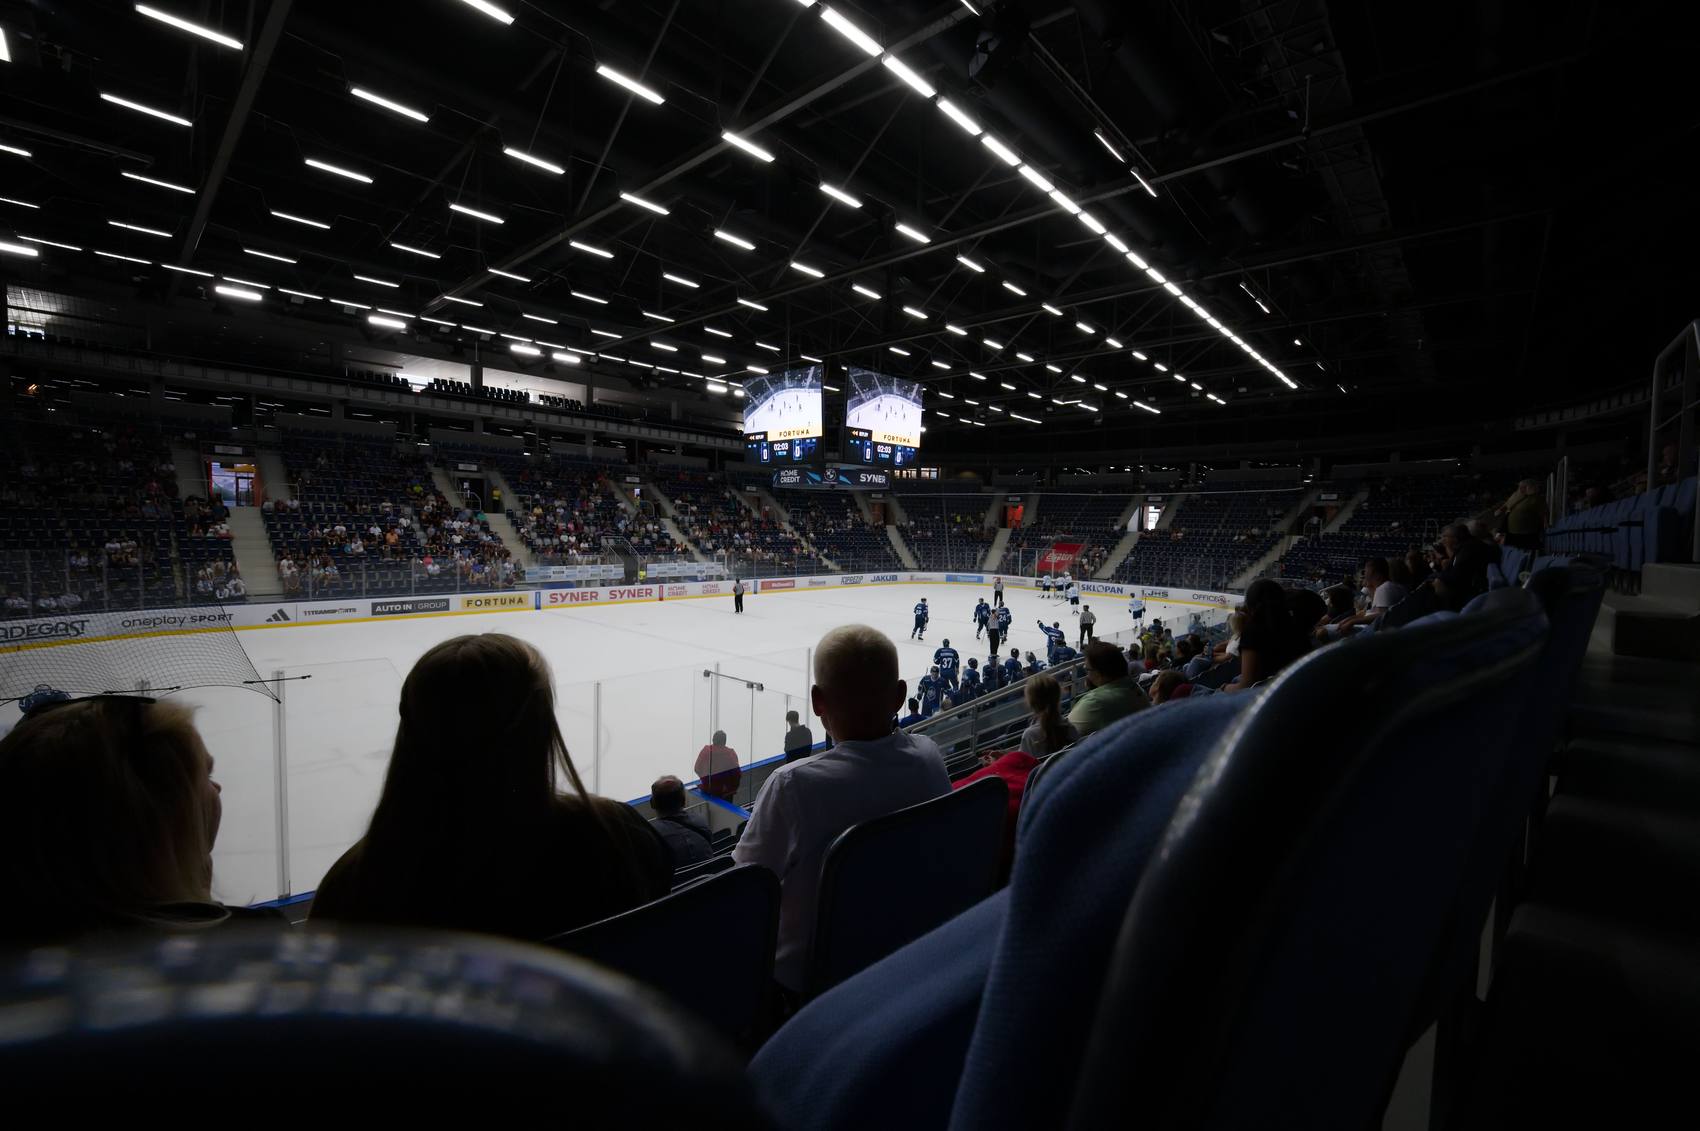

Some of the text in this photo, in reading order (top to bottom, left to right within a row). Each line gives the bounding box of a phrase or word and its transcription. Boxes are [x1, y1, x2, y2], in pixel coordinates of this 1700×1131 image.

[780, 476, 800, 484] CREDIT
[859, 473, 886, 483] SYNER
[870, 574, 898, 582] JAKUB
[549, 587, 653, 603] SYNER SYNER
[466, 597, 524, 607] FORTUNA
[375, 602, 447, 613] AUTO IN GROUP
[121, 613, 234, 628] oneplay SPORT
[942, 657, 953, 669] 37
